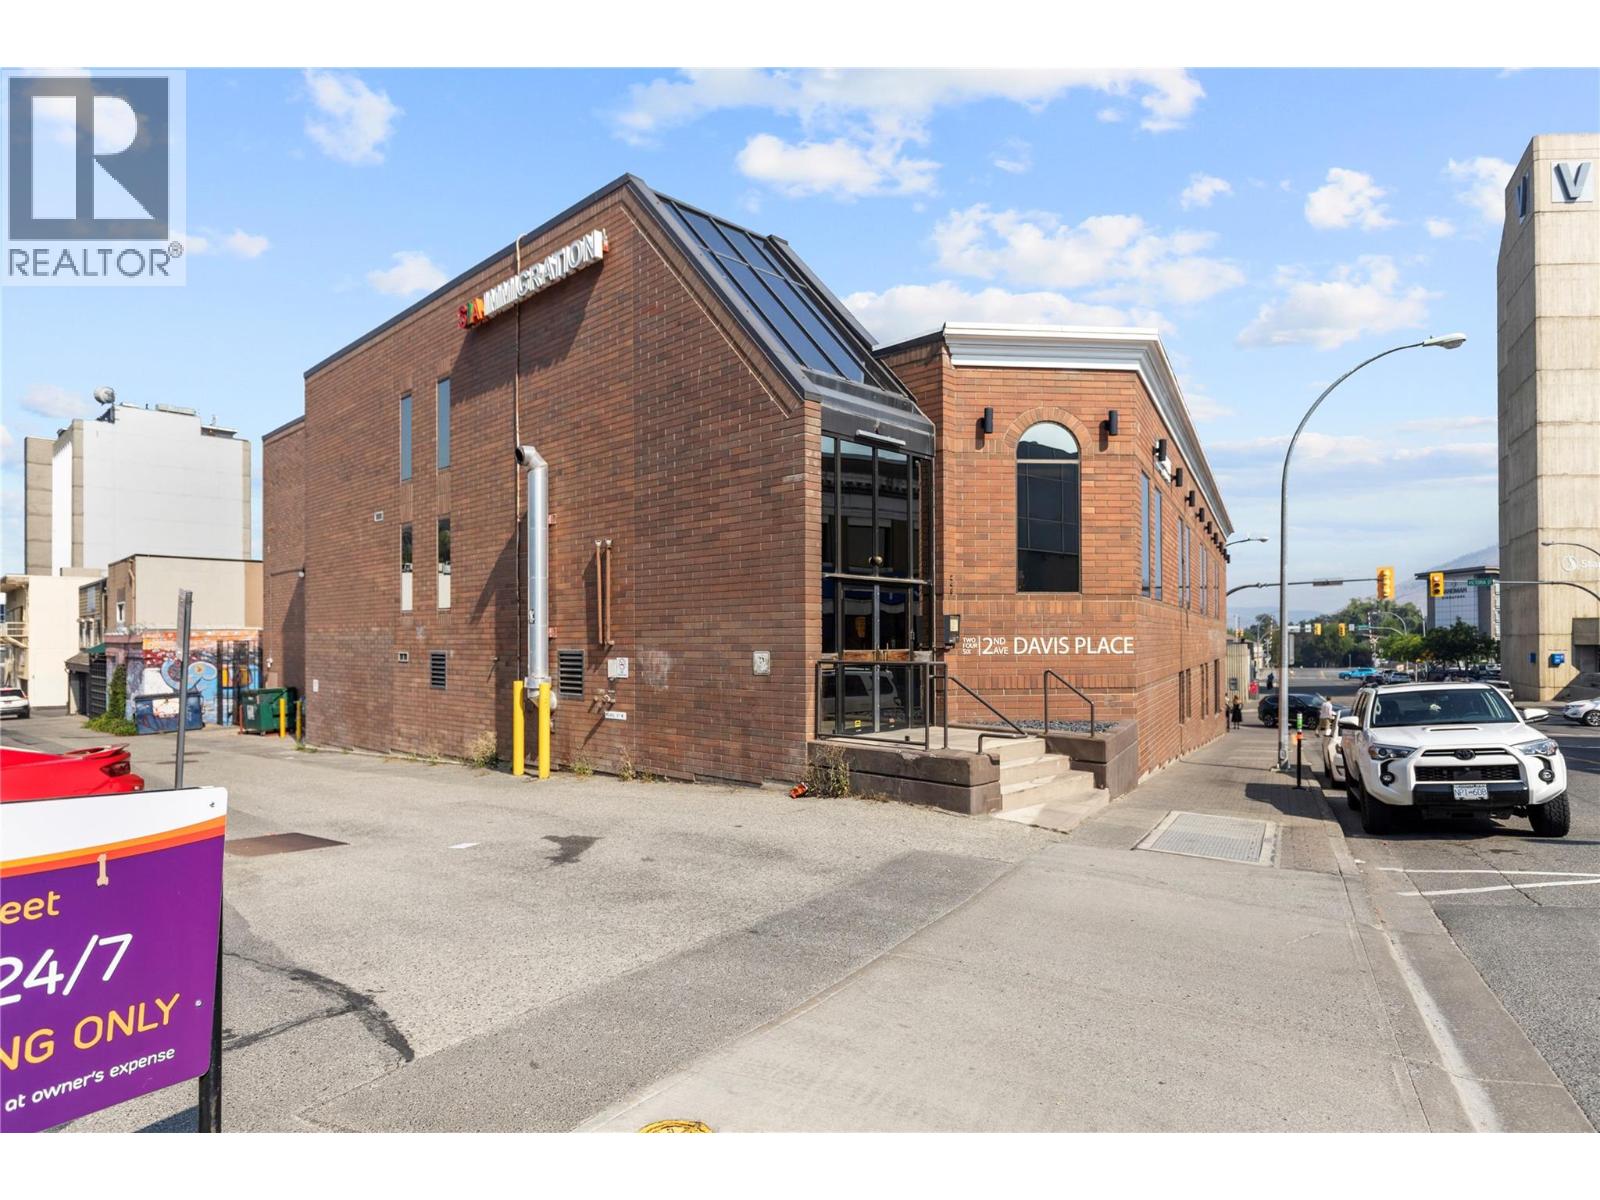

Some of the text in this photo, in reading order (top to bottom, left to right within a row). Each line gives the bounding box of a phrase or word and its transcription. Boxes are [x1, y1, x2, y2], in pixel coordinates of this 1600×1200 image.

[483, 228, 603, 316] IMMIGRATION
[993, 647, 1009, 655] AVE
[1013, 636, 1135, 655] DAVIS PLACE
[0, 933, 133, 1007] 24/7
[74, 993, 181, 1050] ONLY
[5, 1048, 176, 1112] at owner's expense
